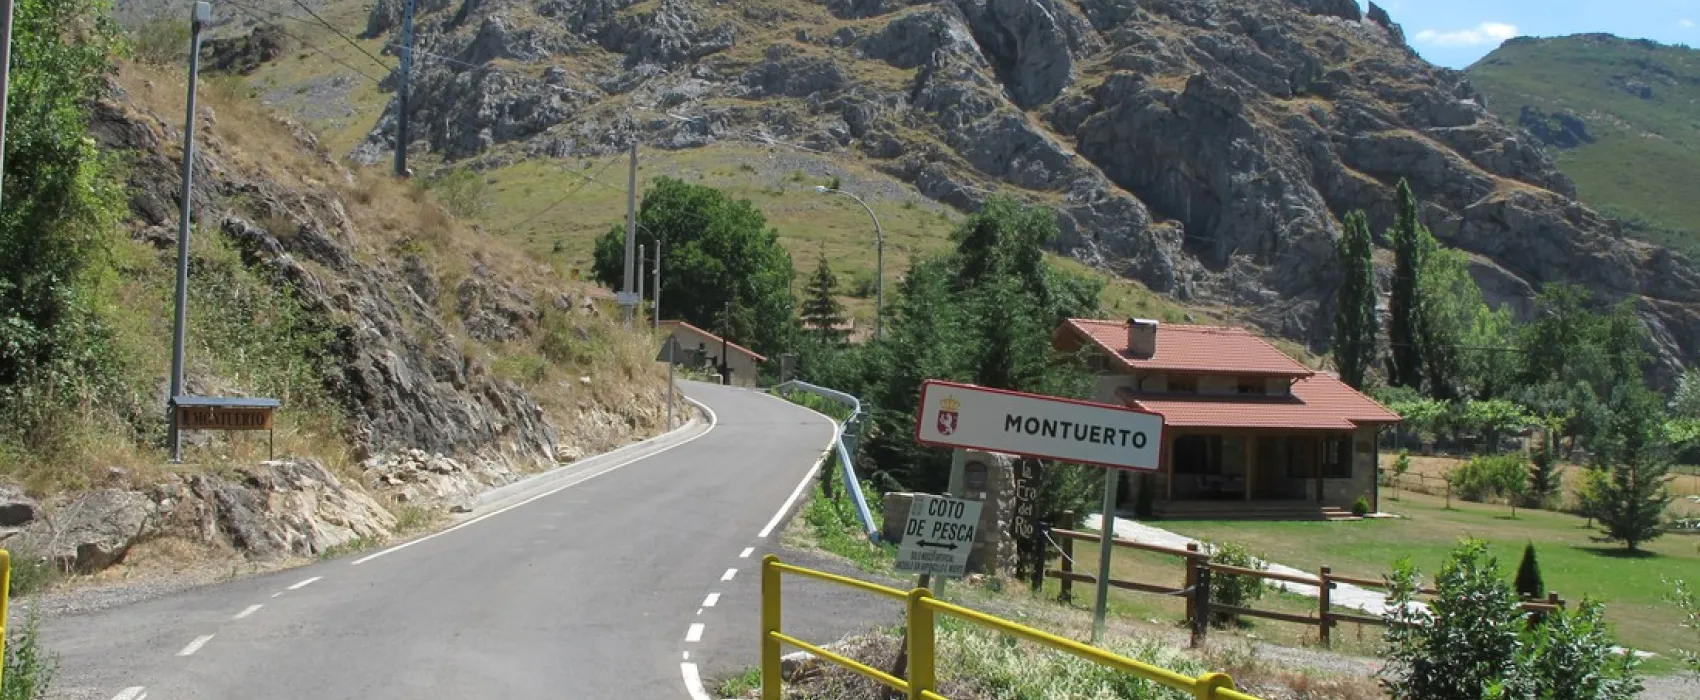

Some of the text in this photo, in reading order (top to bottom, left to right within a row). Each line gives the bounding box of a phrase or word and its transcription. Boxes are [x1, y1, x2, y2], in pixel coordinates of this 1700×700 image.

[1005, 414, 1147, 448] MONTUERTO
[1016, 479, 1036, 502] Era
[928, 498, 964, 518] COTO
[1018, 502, 1033, 516] del
[906, 518, 974, 542] DE PESCA
